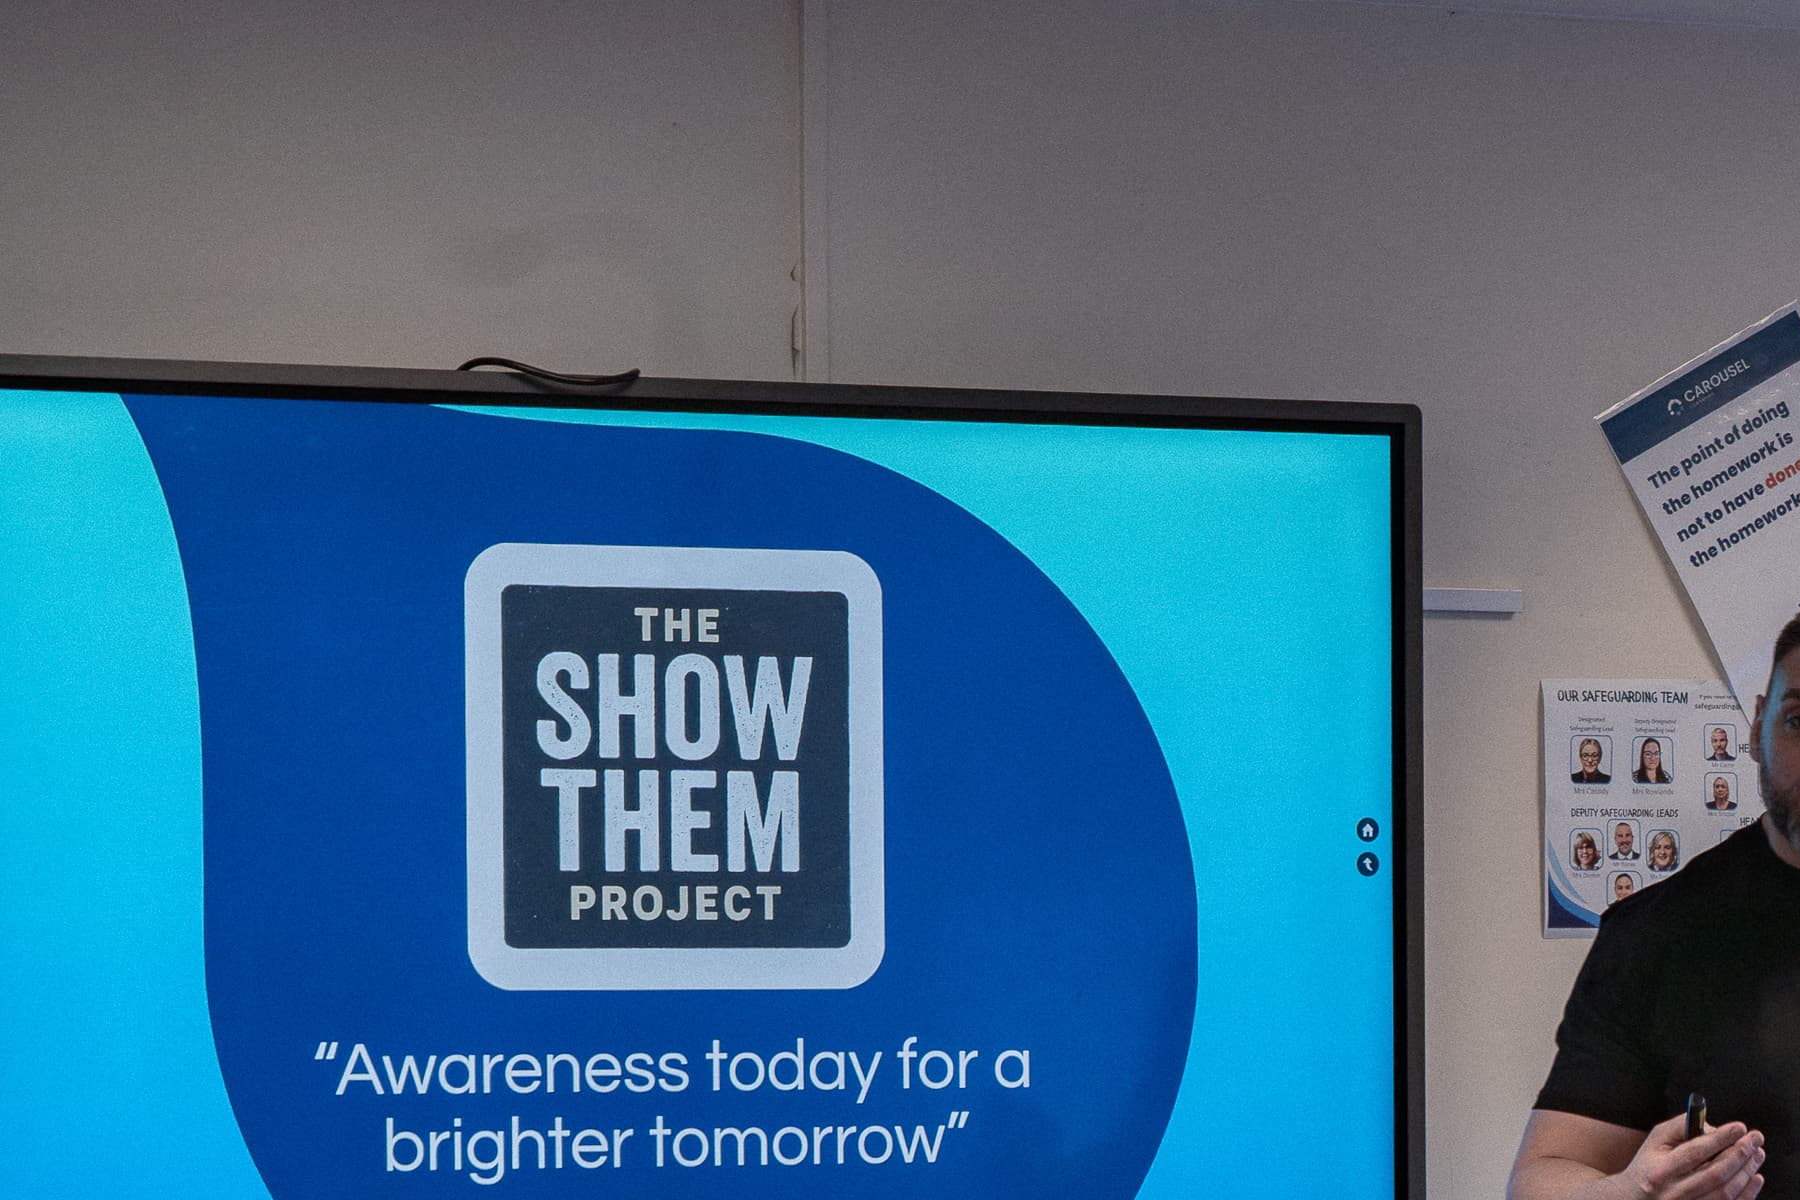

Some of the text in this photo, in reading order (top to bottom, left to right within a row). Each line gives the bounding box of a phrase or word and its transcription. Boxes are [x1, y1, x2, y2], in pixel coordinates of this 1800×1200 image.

[1684, 358, 1751, 402] CAROUSEL
[1648, 401, 1790, 489] The point of doing
[1662, 432, 1793, 515] the homework is
[1677, 518, 1706, 542] not
[1704, 508, 1723, 524] to
[1722, 484, 1764, 514] have
[1690, 546, 1718, 567] the
[634, 607, 720, 643] THE
[536, 651, 813, 760] SHOW
[1557, 690, 1579, 702] OUR
[1582, 690, 1658, 704] SAFEGUARDING
[1661, 691, 1689, 704] TEAM
[540, 768, 800, 872] THEM
[1570, 808, 1679, 818] DEPUTY SAFEGUARDING LEADS
[570, 886, 782, 921] PROJECT
[705, 1038, 883, 1104] today
[896, 1037, 978, 1089] for
[995, 1048, 1031, 1088] a
[386, 1116, 634, 1186] brighter
